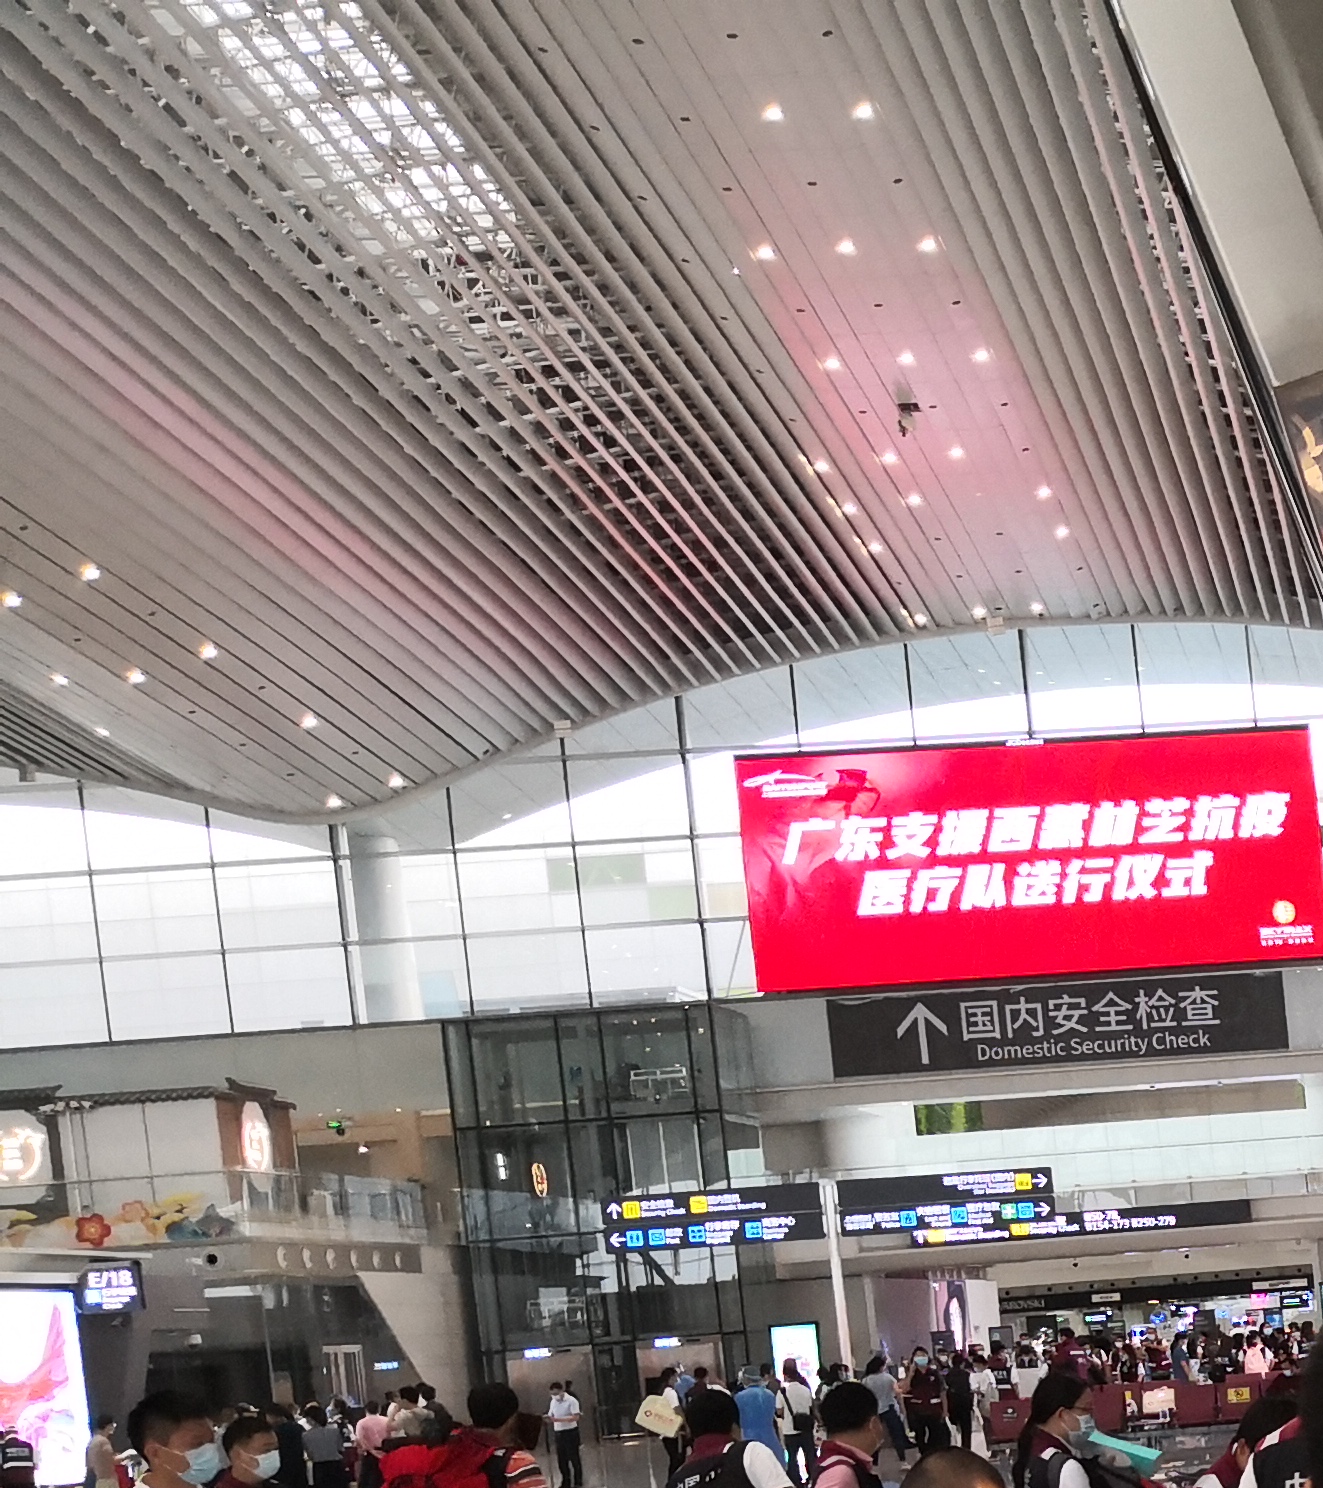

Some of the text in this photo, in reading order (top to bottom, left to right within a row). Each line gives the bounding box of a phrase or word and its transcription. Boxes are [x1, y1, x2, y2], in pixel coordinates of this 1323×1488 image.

[857, 850, 1214, 916] 医疗队送行仪式
[960, 985, 1221, 1042] 国内安全检查
[977, 1029, 1211, 1061] Domestic Security Check
[87, 1269, 134, 1288] E/18
